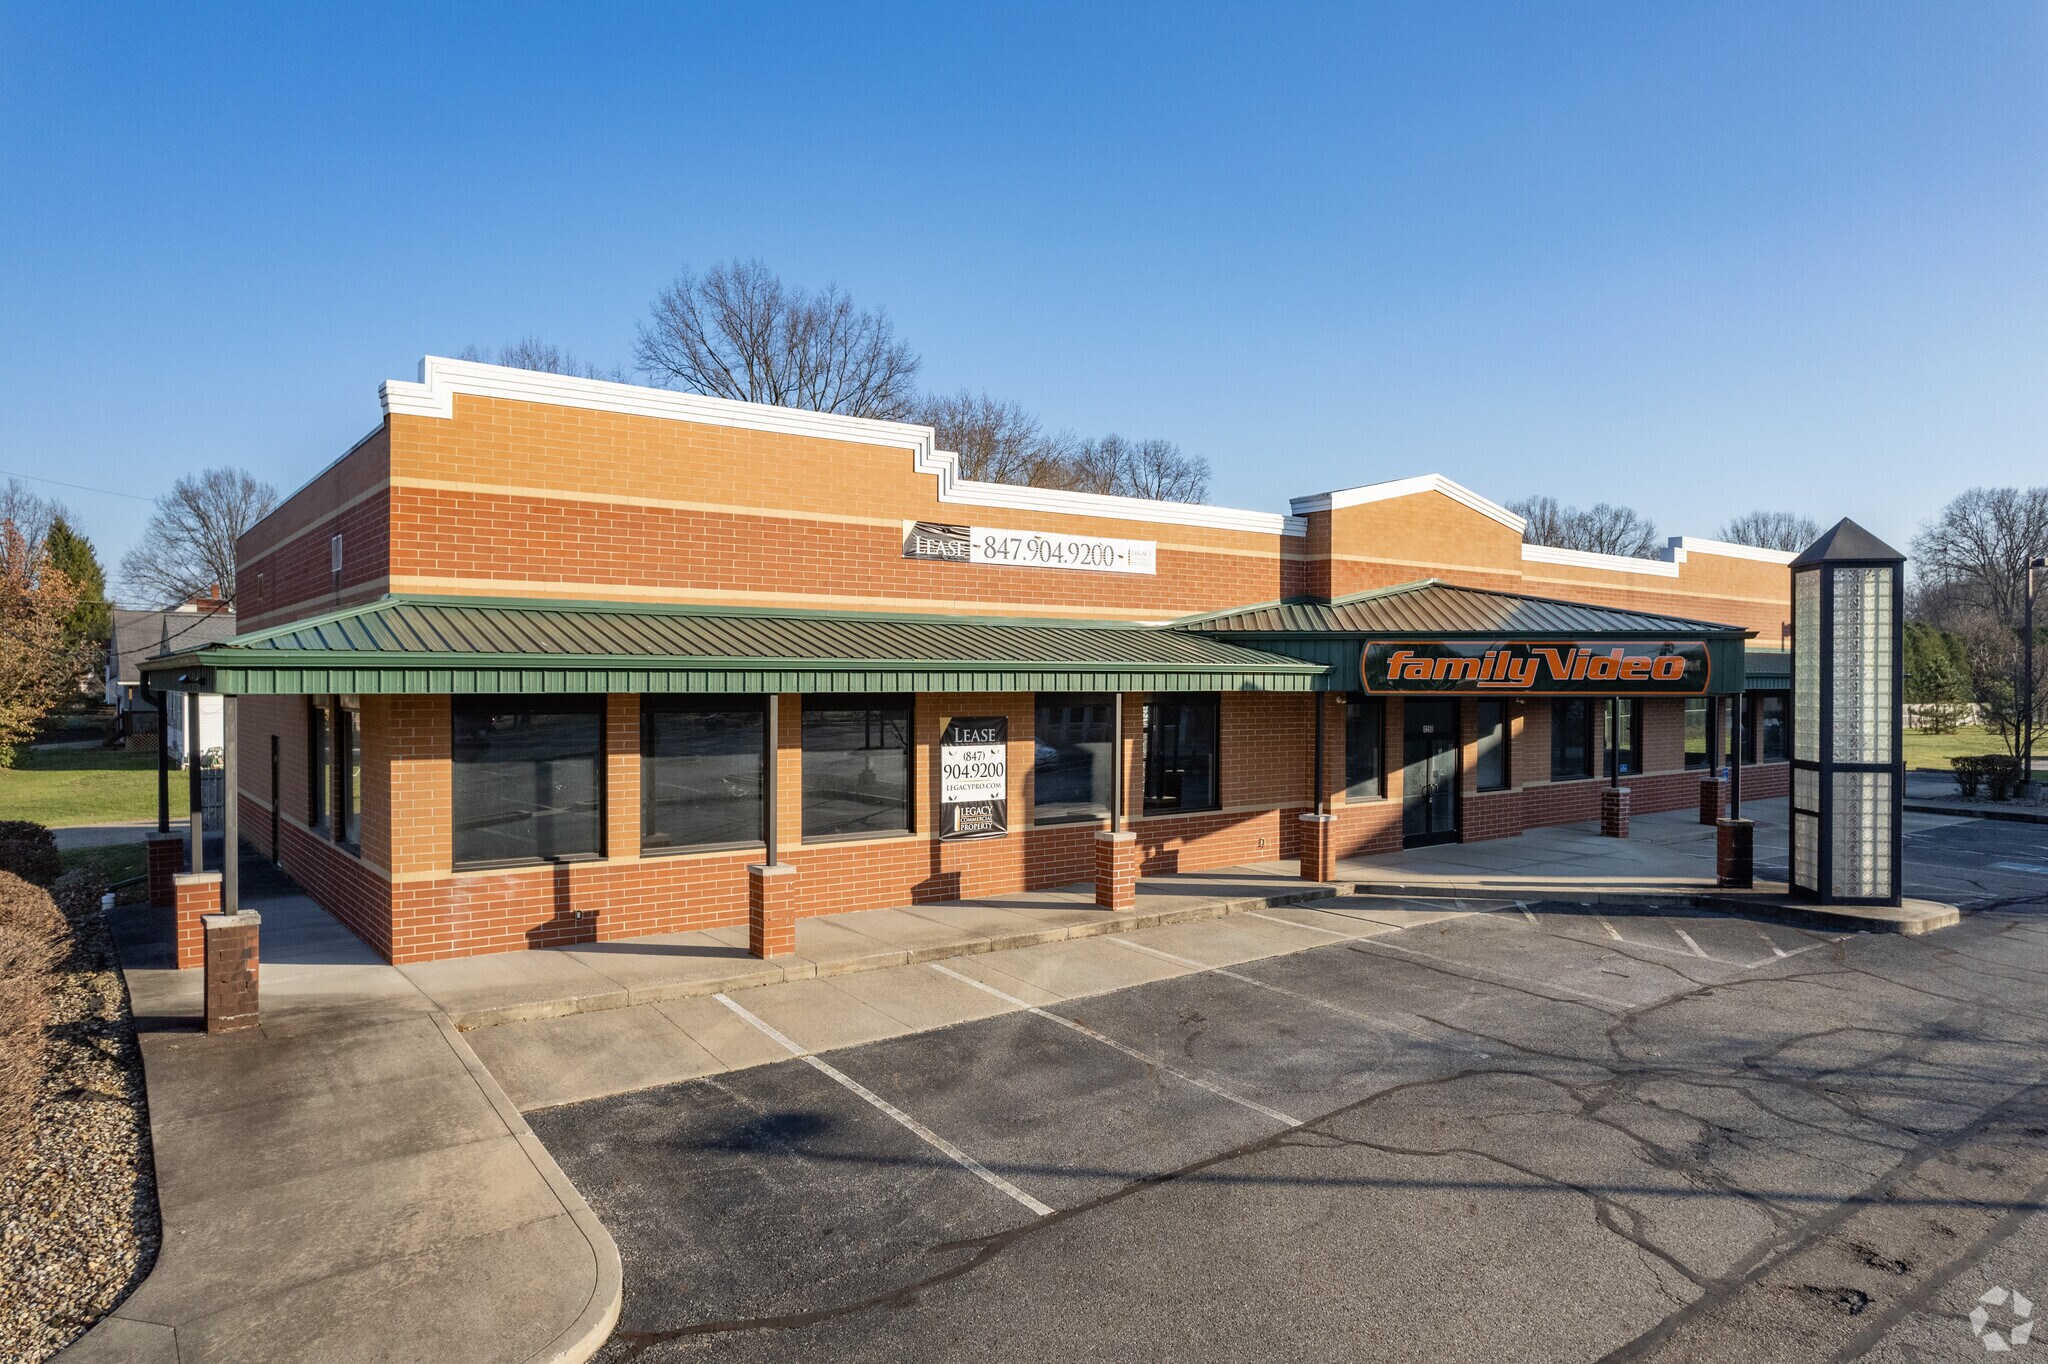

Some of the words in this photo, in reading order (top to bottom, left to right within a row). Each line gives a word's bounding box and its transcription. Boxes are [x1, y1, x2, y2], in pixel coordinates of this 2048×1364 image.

[915, 535, 965, 557] LEASE
[984, 535, 1114, 567] 847.904.9200
[1386, 650, 1540, 688] family
[1531, 648, 1686, 681] Video
[954, 727, 996, 743] LEASE
[963, 750, 986, 762] (847)
[943, 762, 1004, 780] 904.9200
[946, 783, 1002, 792] LEGACYPRO.COM
[961, 805, 993, 816] LEGACY
[961, 823, 993, 831] PROPERTY
